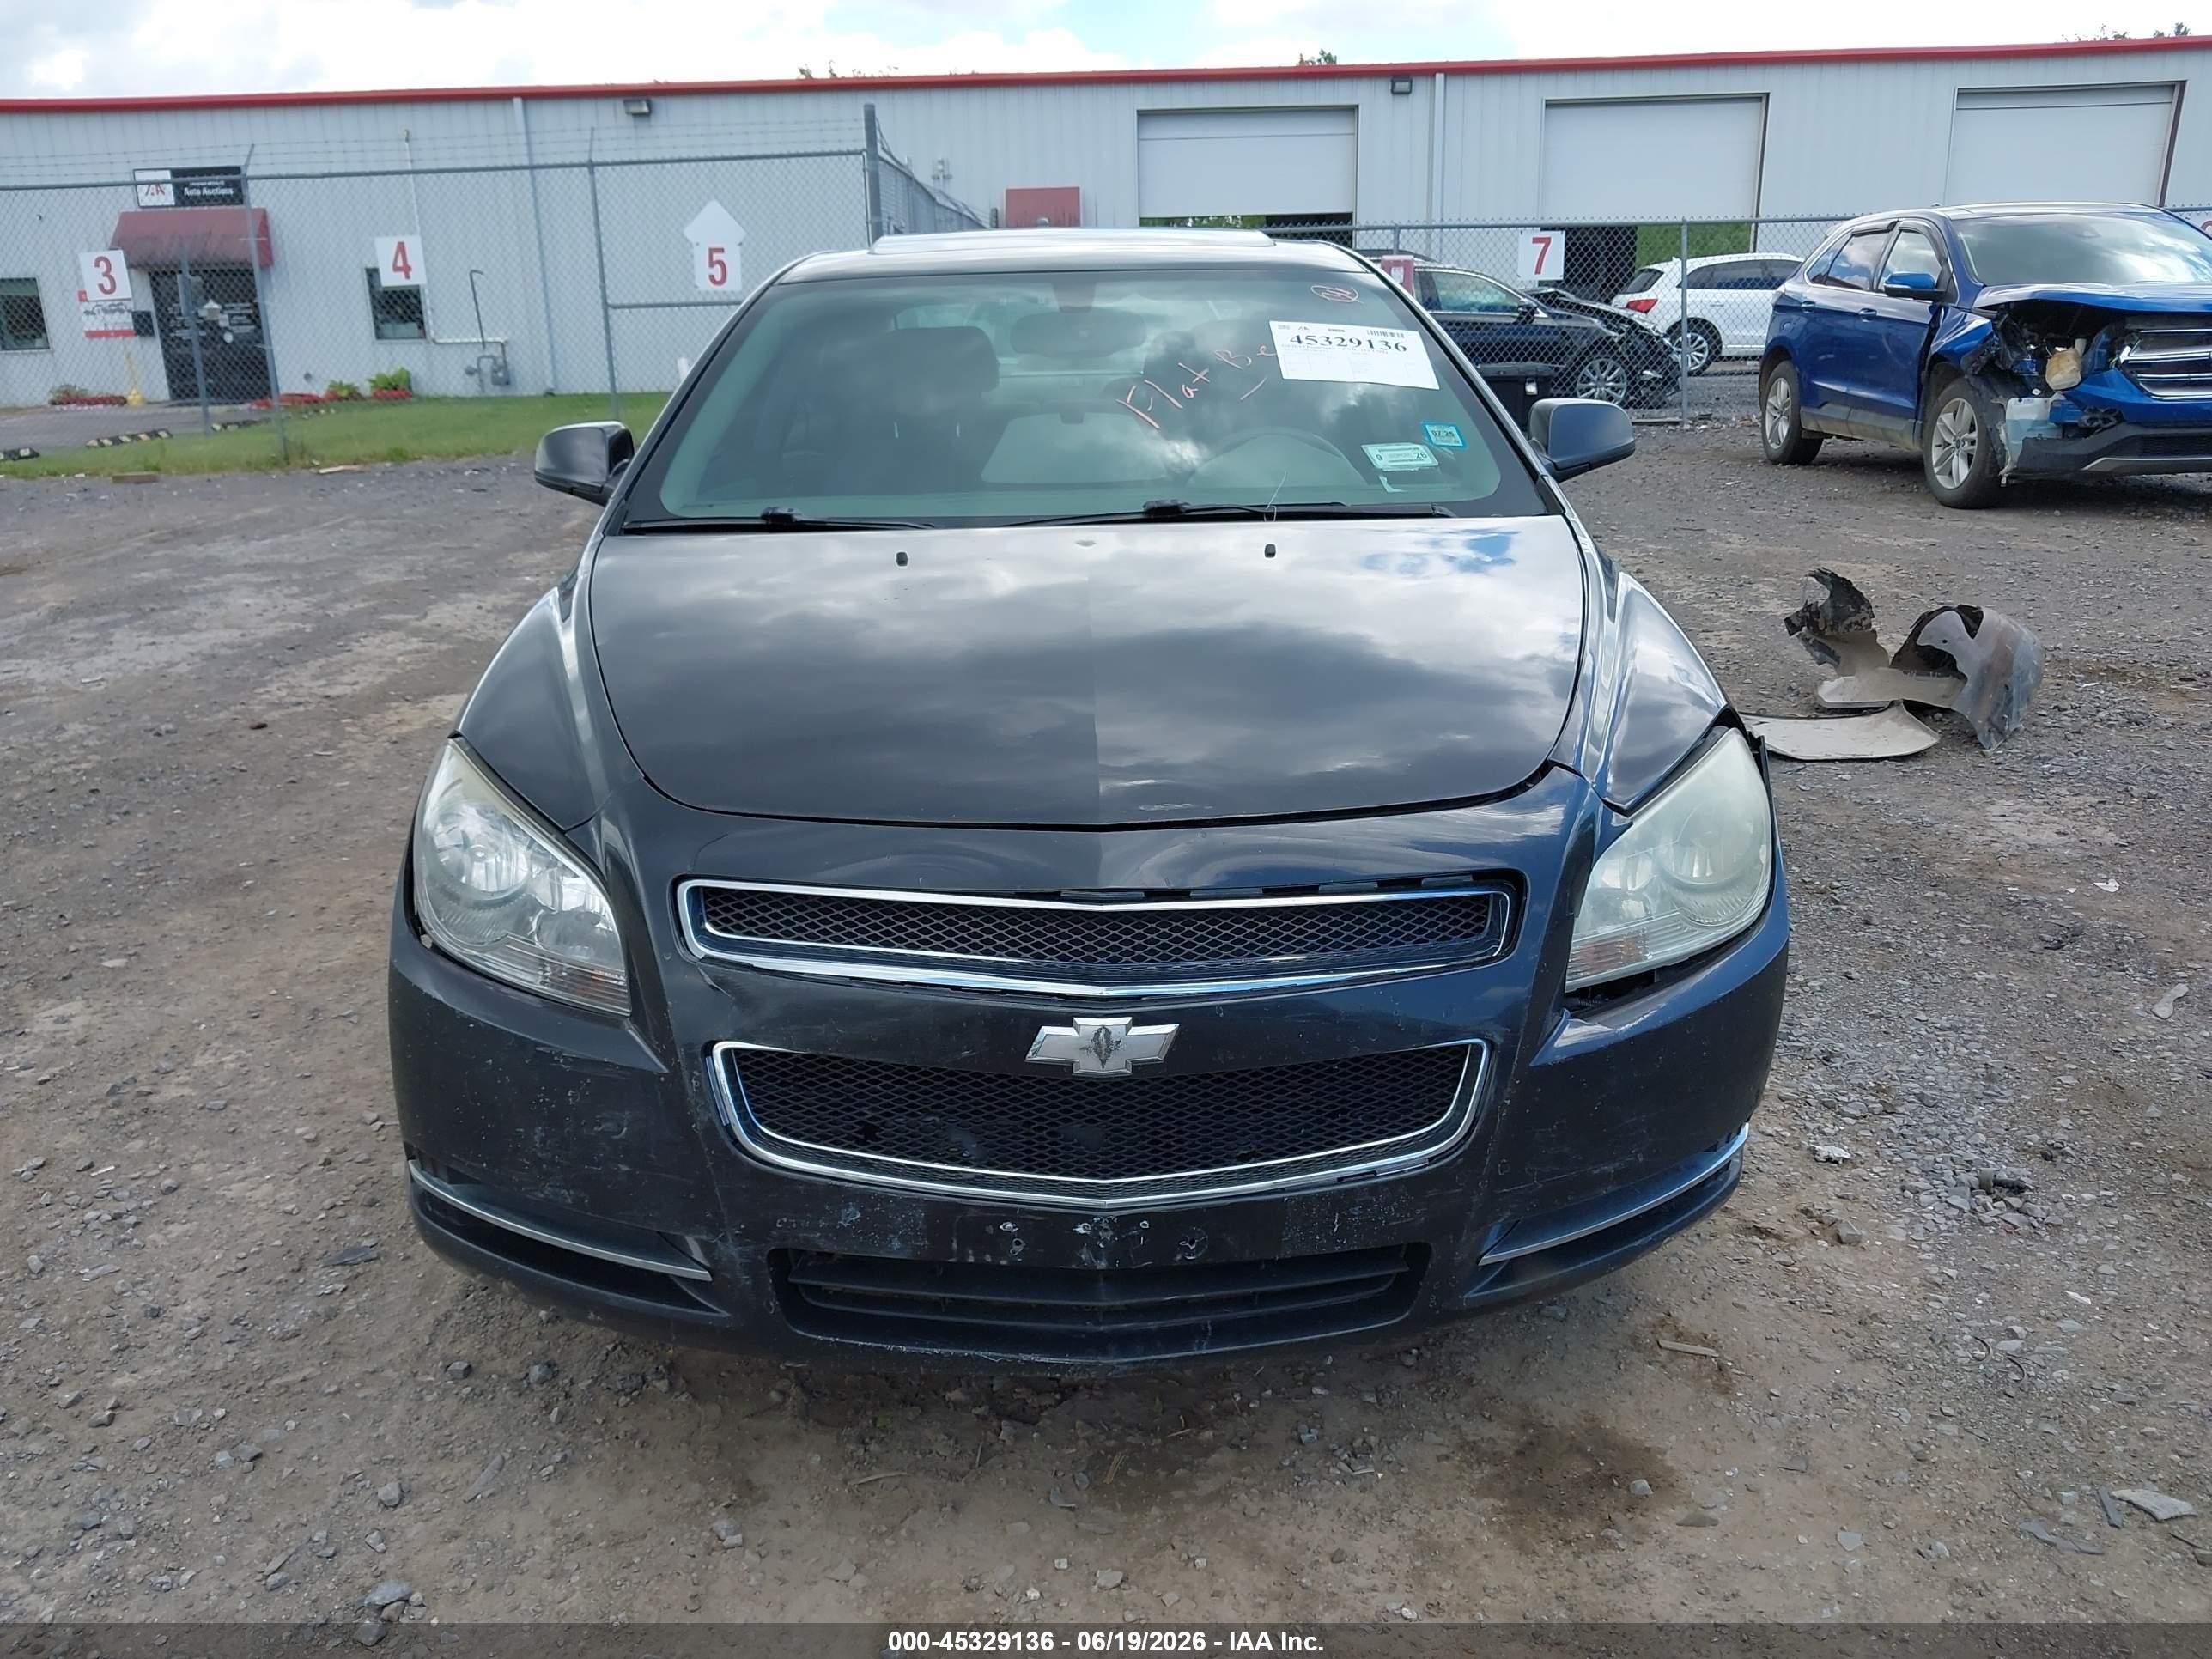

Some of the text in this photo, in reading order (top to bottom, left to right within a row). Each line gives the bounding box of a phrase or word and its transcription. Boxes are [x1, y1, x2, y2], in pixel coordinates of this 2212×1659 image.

[94, 256, 116, 295] 3
[392, 241, 412, 280] 4
[708, 247, 727, 286] 5
[1532, 236, 1552, 276] 7
[1290, 334, 1407, 353] 45329136
